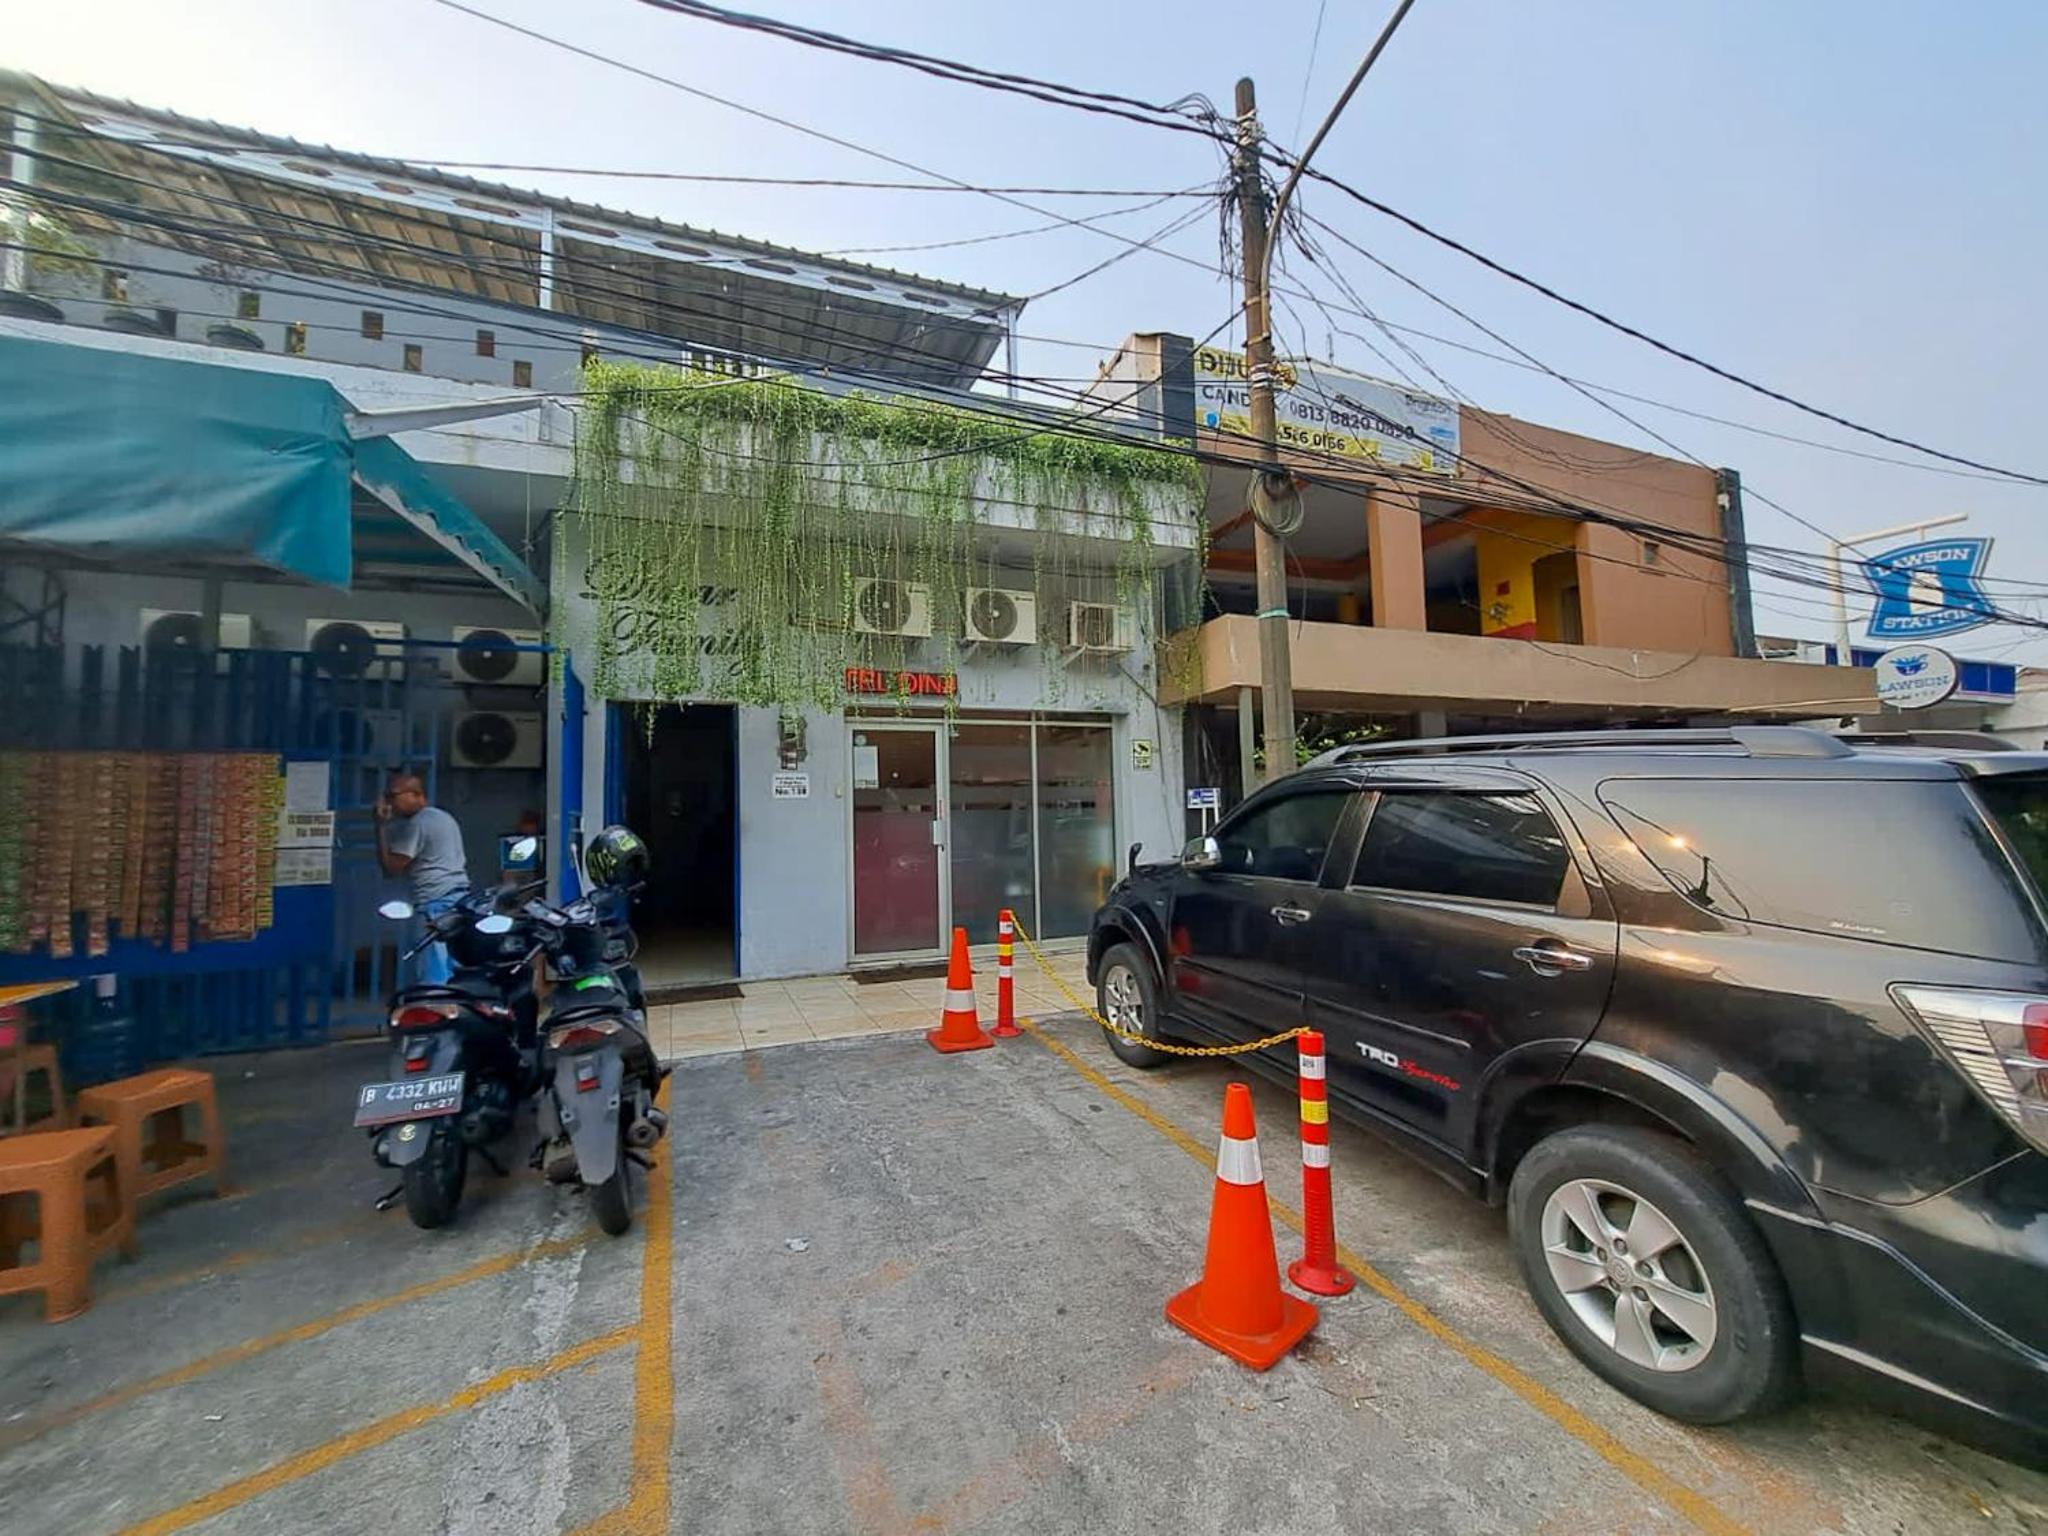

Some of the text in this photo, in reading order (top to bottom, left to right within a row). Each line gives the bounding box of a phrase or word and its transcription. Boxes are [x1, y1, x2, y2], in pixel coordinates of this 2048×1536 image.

[1289, 401, 1324, 421] 0813
[1876, 548, 1969, 576] LAWSON
[1877, 675, 1949, 693] LAWSON
[1355, 1041, 1398, 1068] TRD
[366, 1088, 376, 1103] B
